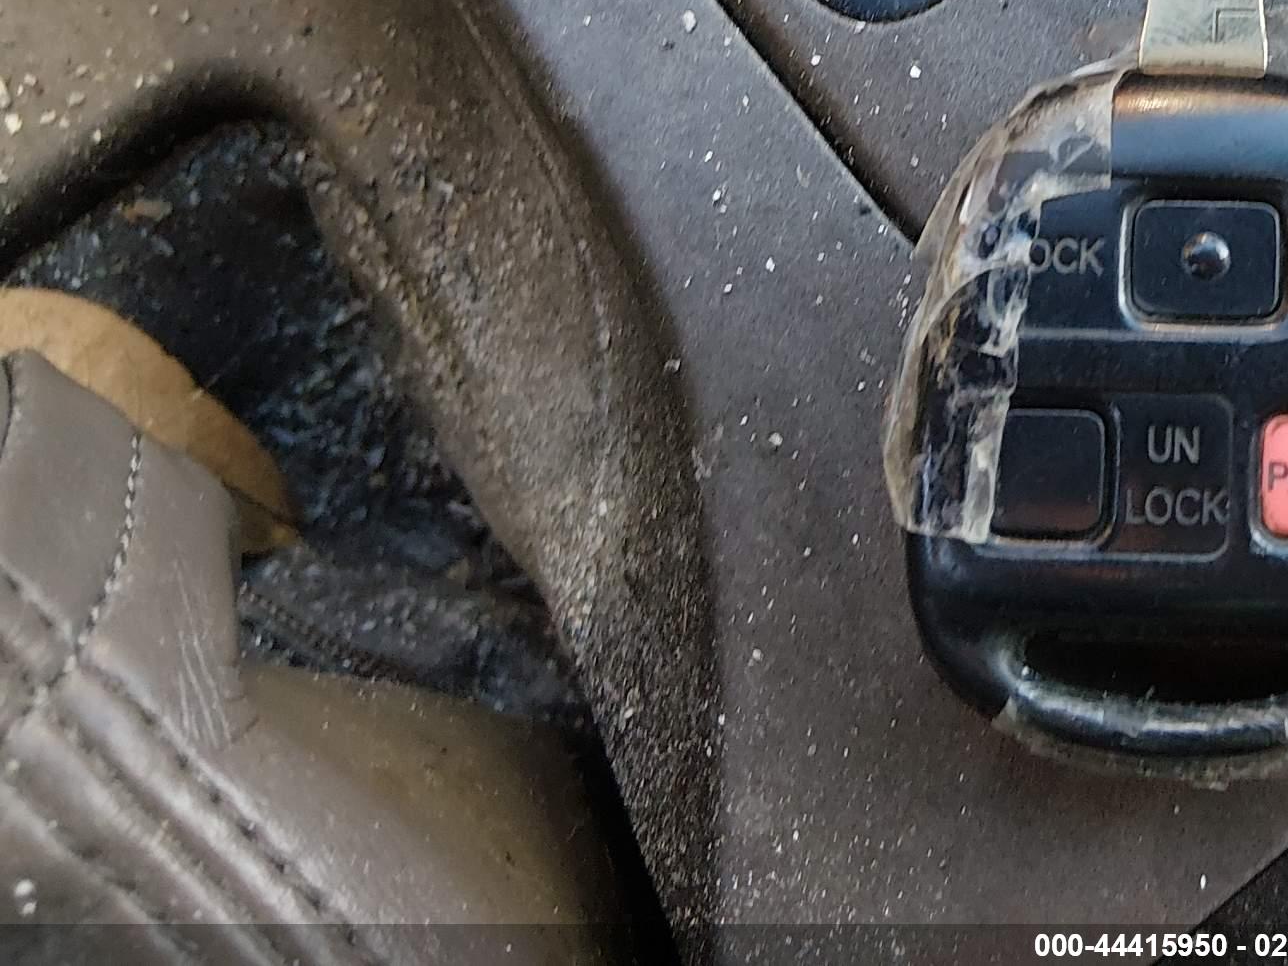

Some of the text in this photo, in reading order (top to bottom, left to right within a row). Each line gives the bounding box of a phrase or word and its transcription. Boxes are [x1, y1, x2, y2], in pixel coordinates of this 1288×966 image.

[1026, 236, 1105, 276] OCK
[1147, 425, 1200, 464] UN
[1125, 486, 1230, 526] LOCK
